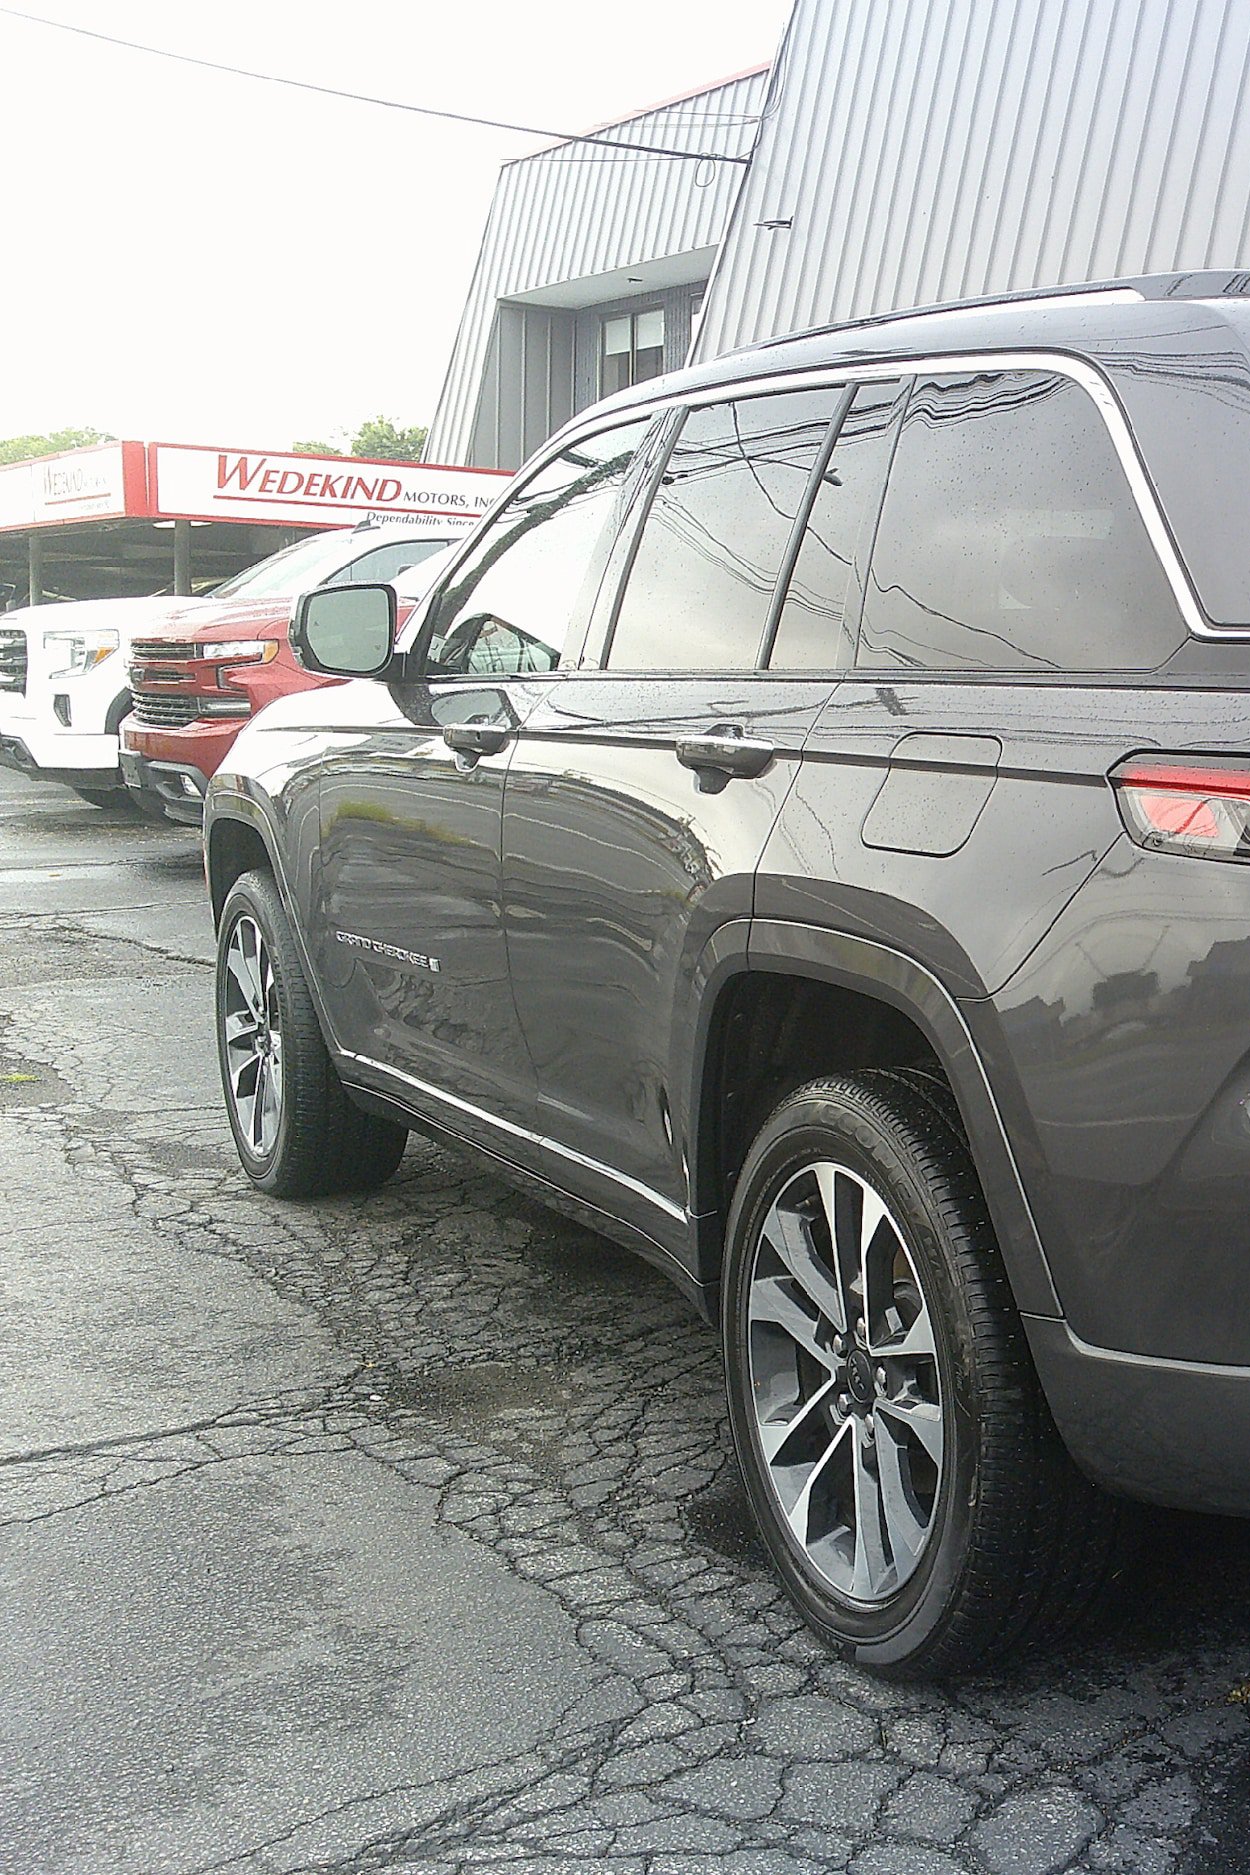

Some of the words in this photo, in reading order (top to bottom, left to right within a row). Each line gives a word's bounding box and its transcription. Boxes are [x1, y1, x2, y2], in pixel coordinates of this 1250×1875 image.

[217, 455, 402, 501] WEDEKIND
[403, 491, 469, 508] MOTORS,
[367, 511, 441, 526] Dependability
[336, 930, 371, 949] GRAND
[372, 940, 429, 968] CHEROKEE
